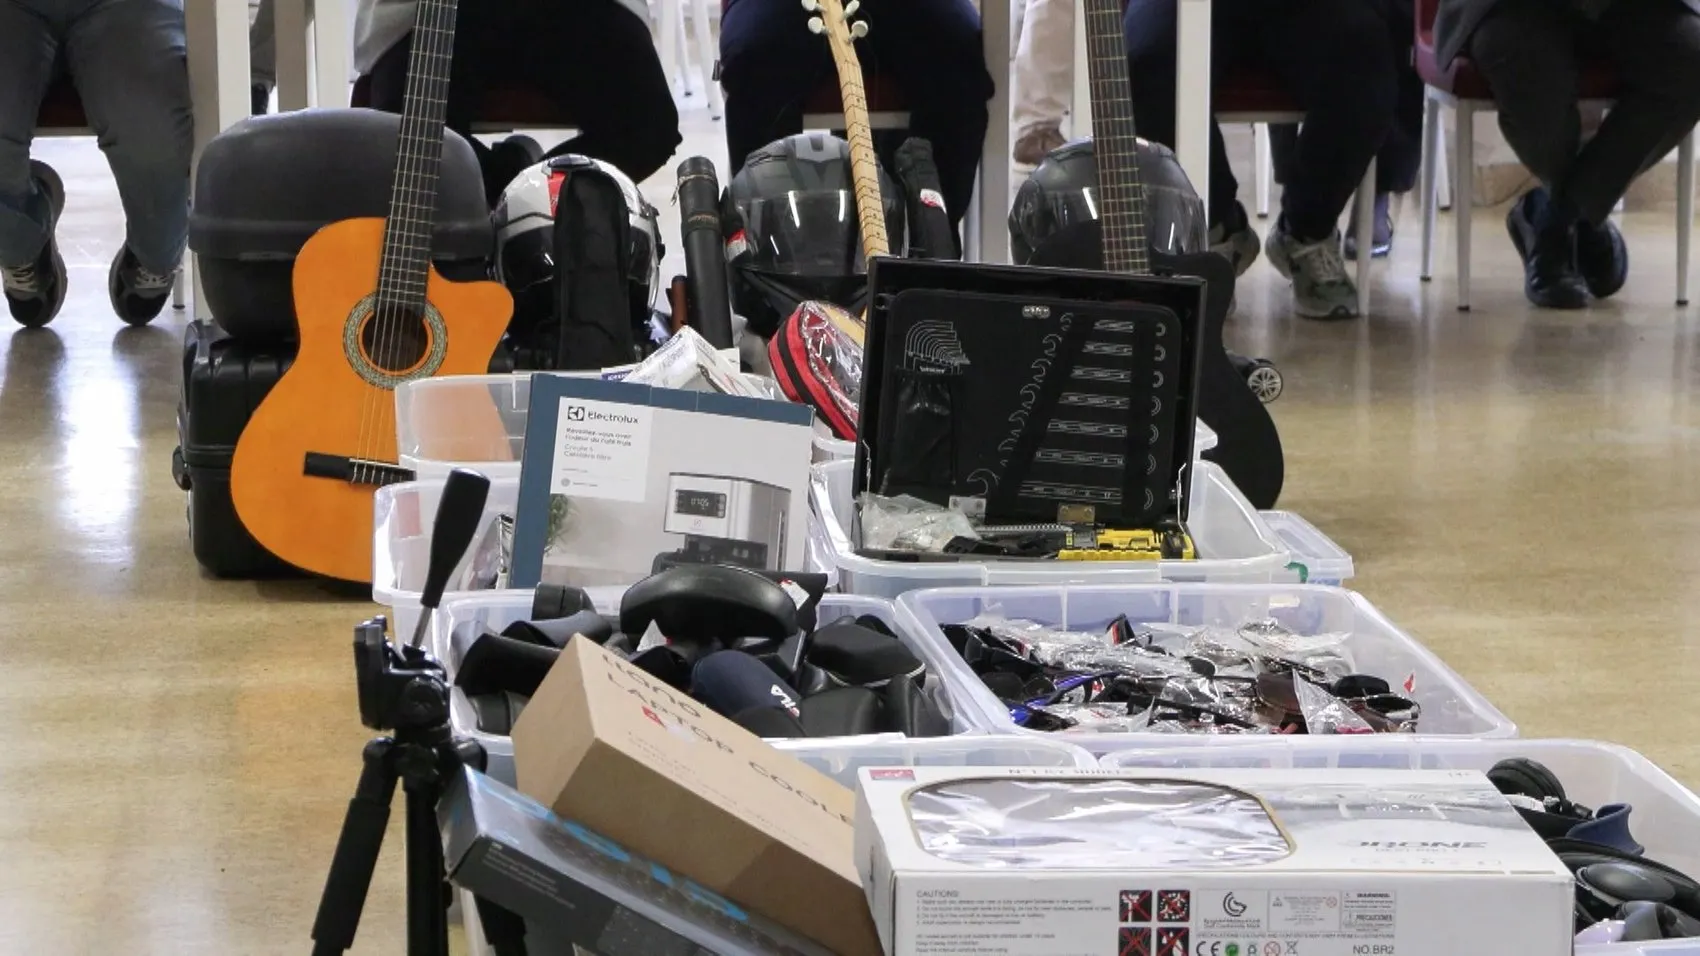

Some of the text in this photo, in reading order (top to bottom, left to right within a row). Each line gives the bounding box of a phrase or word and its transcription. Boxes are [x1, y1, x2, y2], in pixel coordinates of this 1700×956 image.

[587, 410, 640, 424] Electrolux
[607, 671, 735, 755] LAPTOP
[748, 761, 851, 825] COOLE
